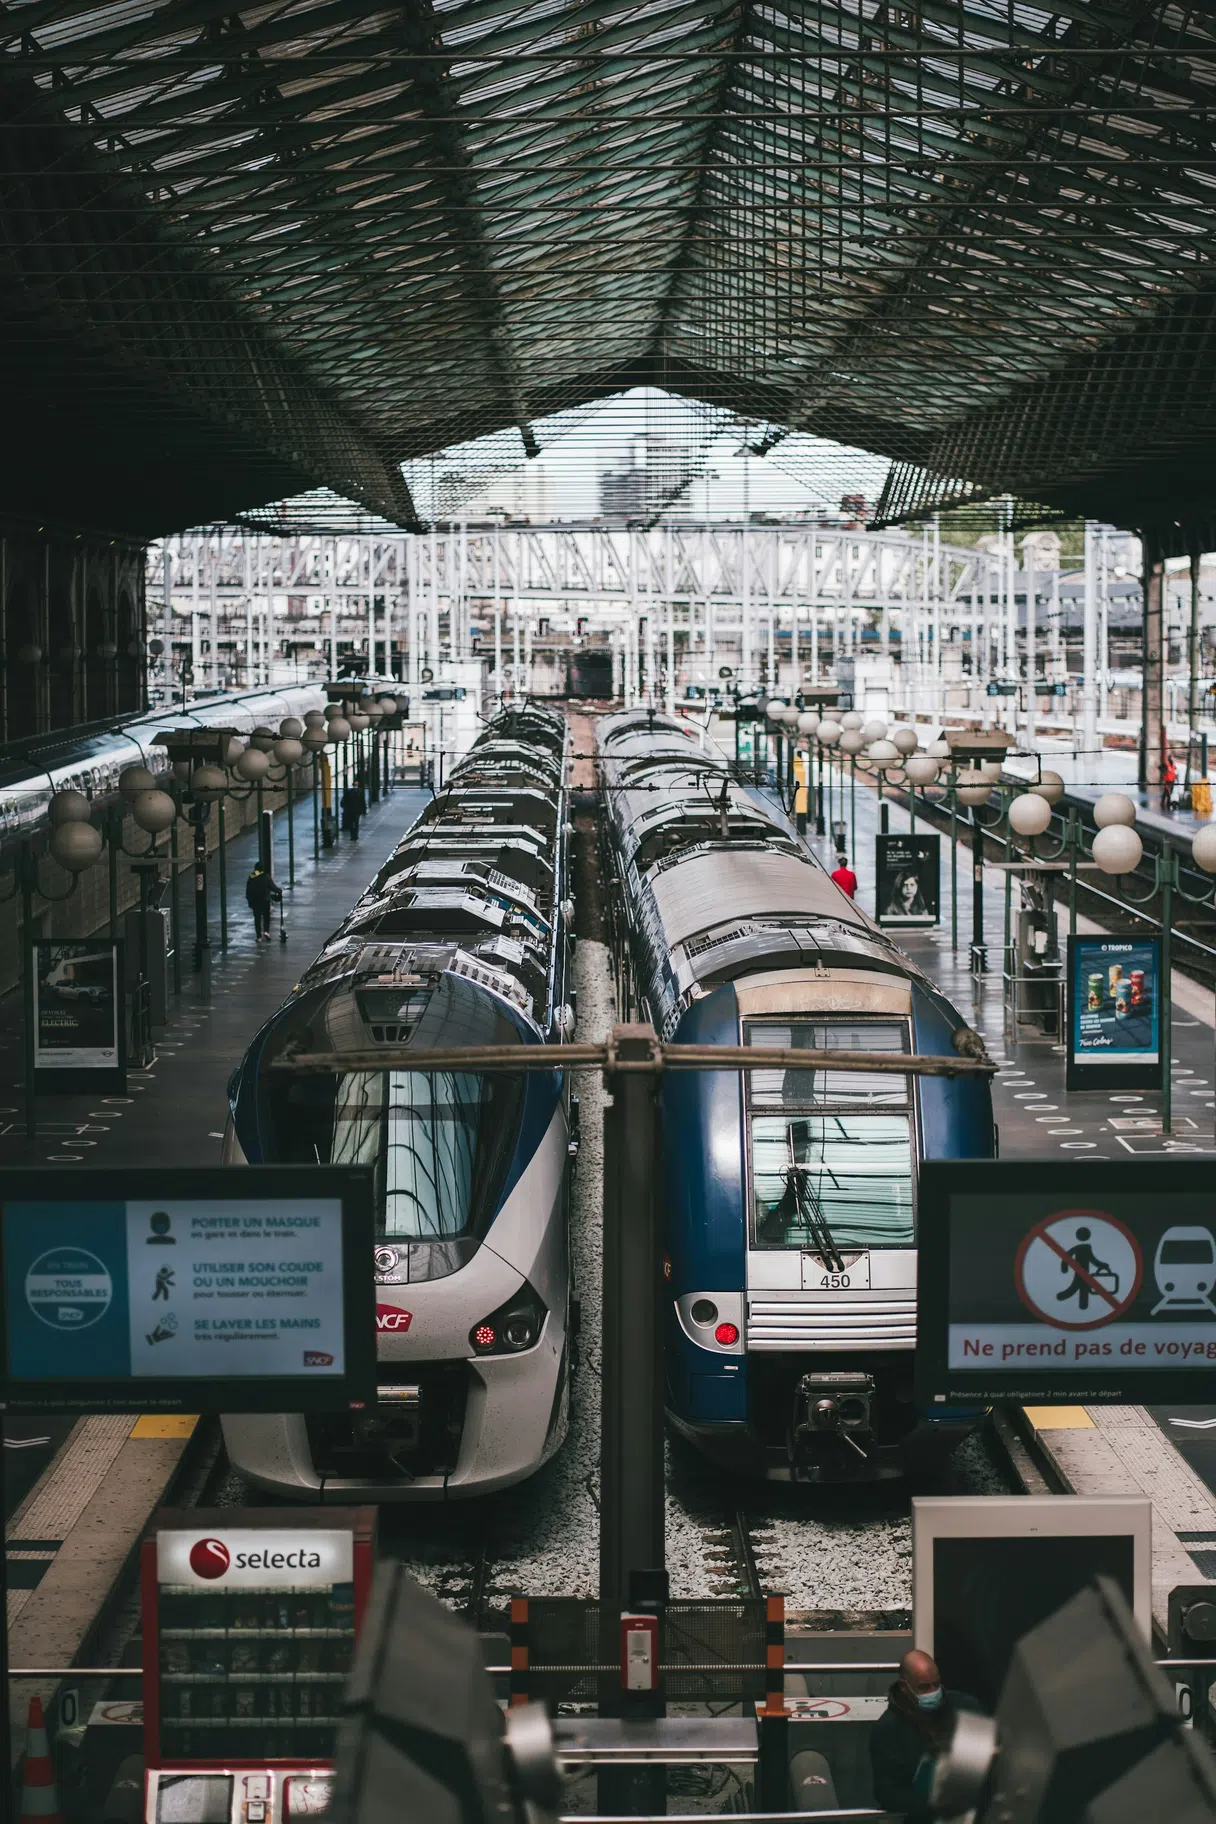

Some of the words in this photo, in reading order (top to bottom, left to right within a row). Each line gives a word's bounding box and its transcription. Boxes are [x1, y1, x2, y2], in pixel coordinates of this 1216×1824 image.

[192, 1217, 240, 1228] PORTER
[244, 1217, 262, 1228] UN
[266, 1216, 320, 1228] MASQUE
[204, 1231, 225, 1240] gare
[228, 1230, 237, 1238] et
[240, 1230, 260, 1238] dans
[264, 1230, 272, 1238] le
[193, 1263, 244, 1273] UTILISER
[248, 1262, 275, 1273] SON
[278, 1262, 323, 1272] COUDE
[54, 1280, 82, 1288] TOUS
[194, 1277, 212, 1287] OU
[216, 1277, 234, 1287] UN
[238, 1276, 308, 1287] MOUCHOIR
[820, 1274, 850, 1288] 450
[30, 1289, 108, 1298] RESPONSABLES
[194, 1291, 214, 1300] pour
[217, 1290, 249, 1298] tousser
[194, 1319, 209, 1330] SE
[212, 1319, 251, 1330] LAVER
[255, 1318, 276, 1329] LES
[280, 1318, 320, 1328] MAINS
[376, 1314, 408, 1328] NCF
[964, 1339, 994, 1356] Ne
[1002, 1338, 1066, 1360] prend
[1074, 1341, 1112, 1360] pas
[1120, 1338, 1146, 1356] de
[1154, 1341, 1216, 1360] voyag
[306, 1355, 332, 1365] SNCF
[950, 1390, 982, 1398] Présence
[990, 1390, 1004, 1400] quai
[1007, 1390, 1046, 1400] obligatoire
[1047, 1390, 1052, 1398] 2
[1053, 1390, 1066, 1398] min
[1068, 1390, 1088, 1398] avant
[1098, 1390, 1122, 1398] départ
[235, 1549, 320, 1569] selecta
